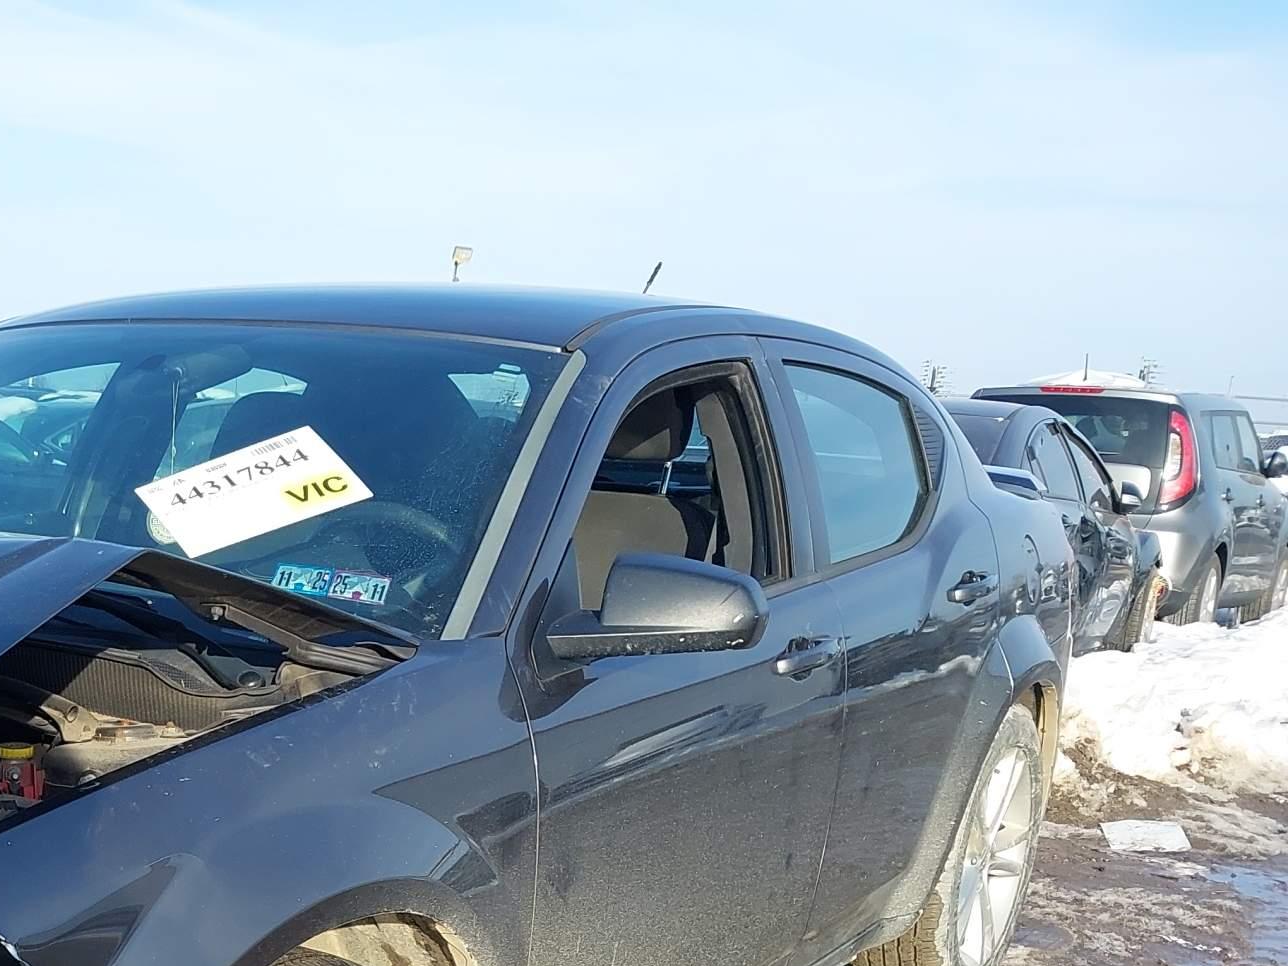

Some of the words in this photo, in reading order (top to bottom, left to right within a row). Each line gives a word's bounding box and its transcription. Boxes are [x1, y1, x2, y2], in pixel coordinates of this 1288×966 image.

[170, 448, 309, 507] 44317844
[285, 476, 348, 503] VIC
[278, 571, 293, 587] 11
[312, 571, 329, 591] 25
[332, 574, 350, 595] 25
[372, 584, 386, 602] 11
